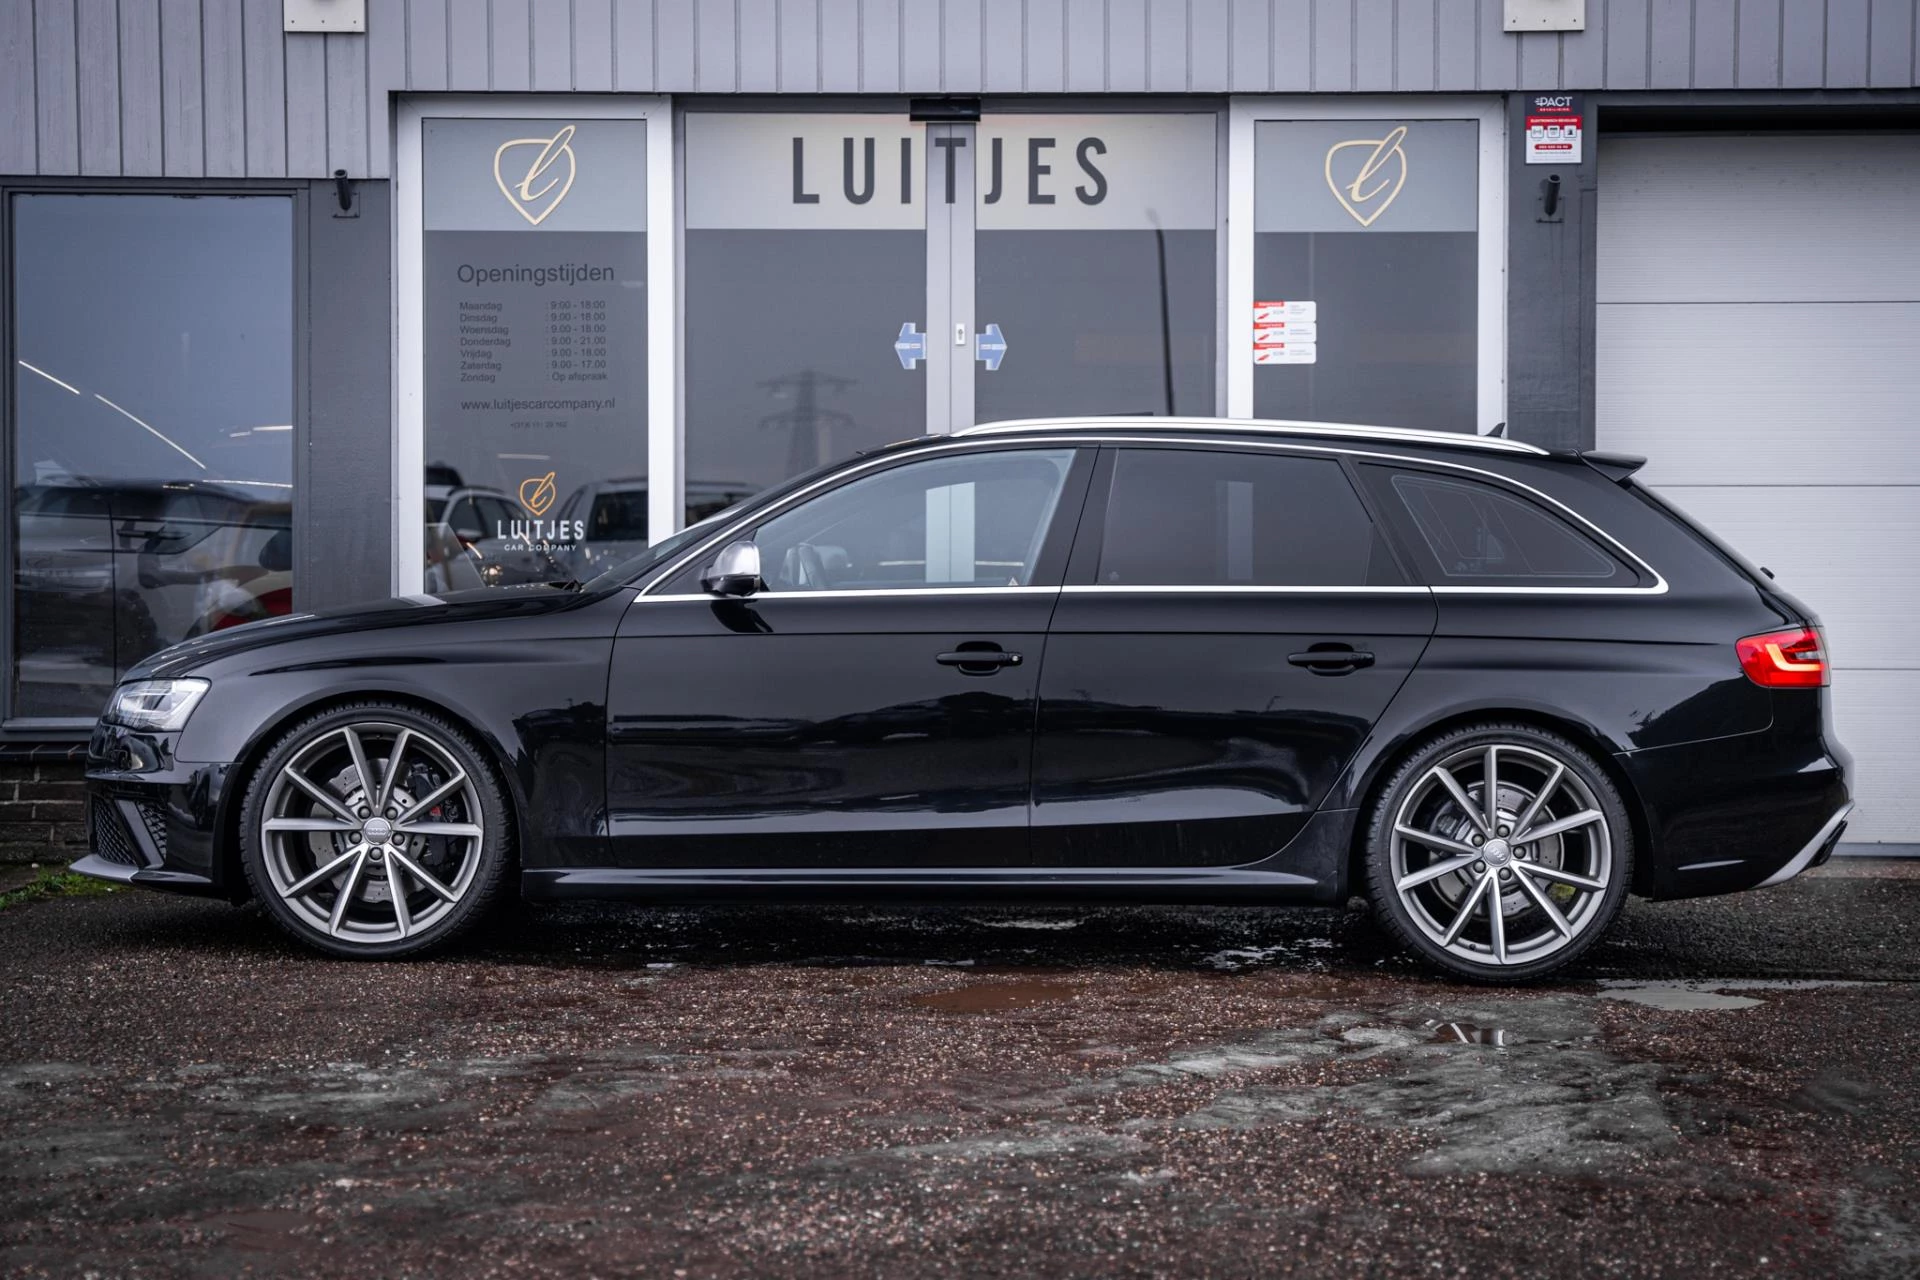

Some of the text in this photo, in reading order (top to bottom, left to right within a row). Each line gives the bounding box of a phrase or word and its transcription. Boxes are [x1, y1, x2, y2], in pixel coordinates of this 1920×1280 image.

[793, 137, 1107, 206] LUITJES
[457, 264, 615, 287] Openingstijden
[459, 302, 503, 312] Maandag
[459, 313, 497, 324] Dinsdag
[459, 325, 509, 336] Woensdag
[460, 337, 511, 348] Donderdag
[460, 349, 493, 360] Vrijdag
[460, 361, 502, 371] Zaterdag
[460, 373, 496, 383] Zondag
[552, 371, 566, 382] Op
[461, 397, 616, 413] www.luitjescarcompany.nl
[497, 520, 584, 540] LUITJES
[504, 544, 524, 552] CAR
